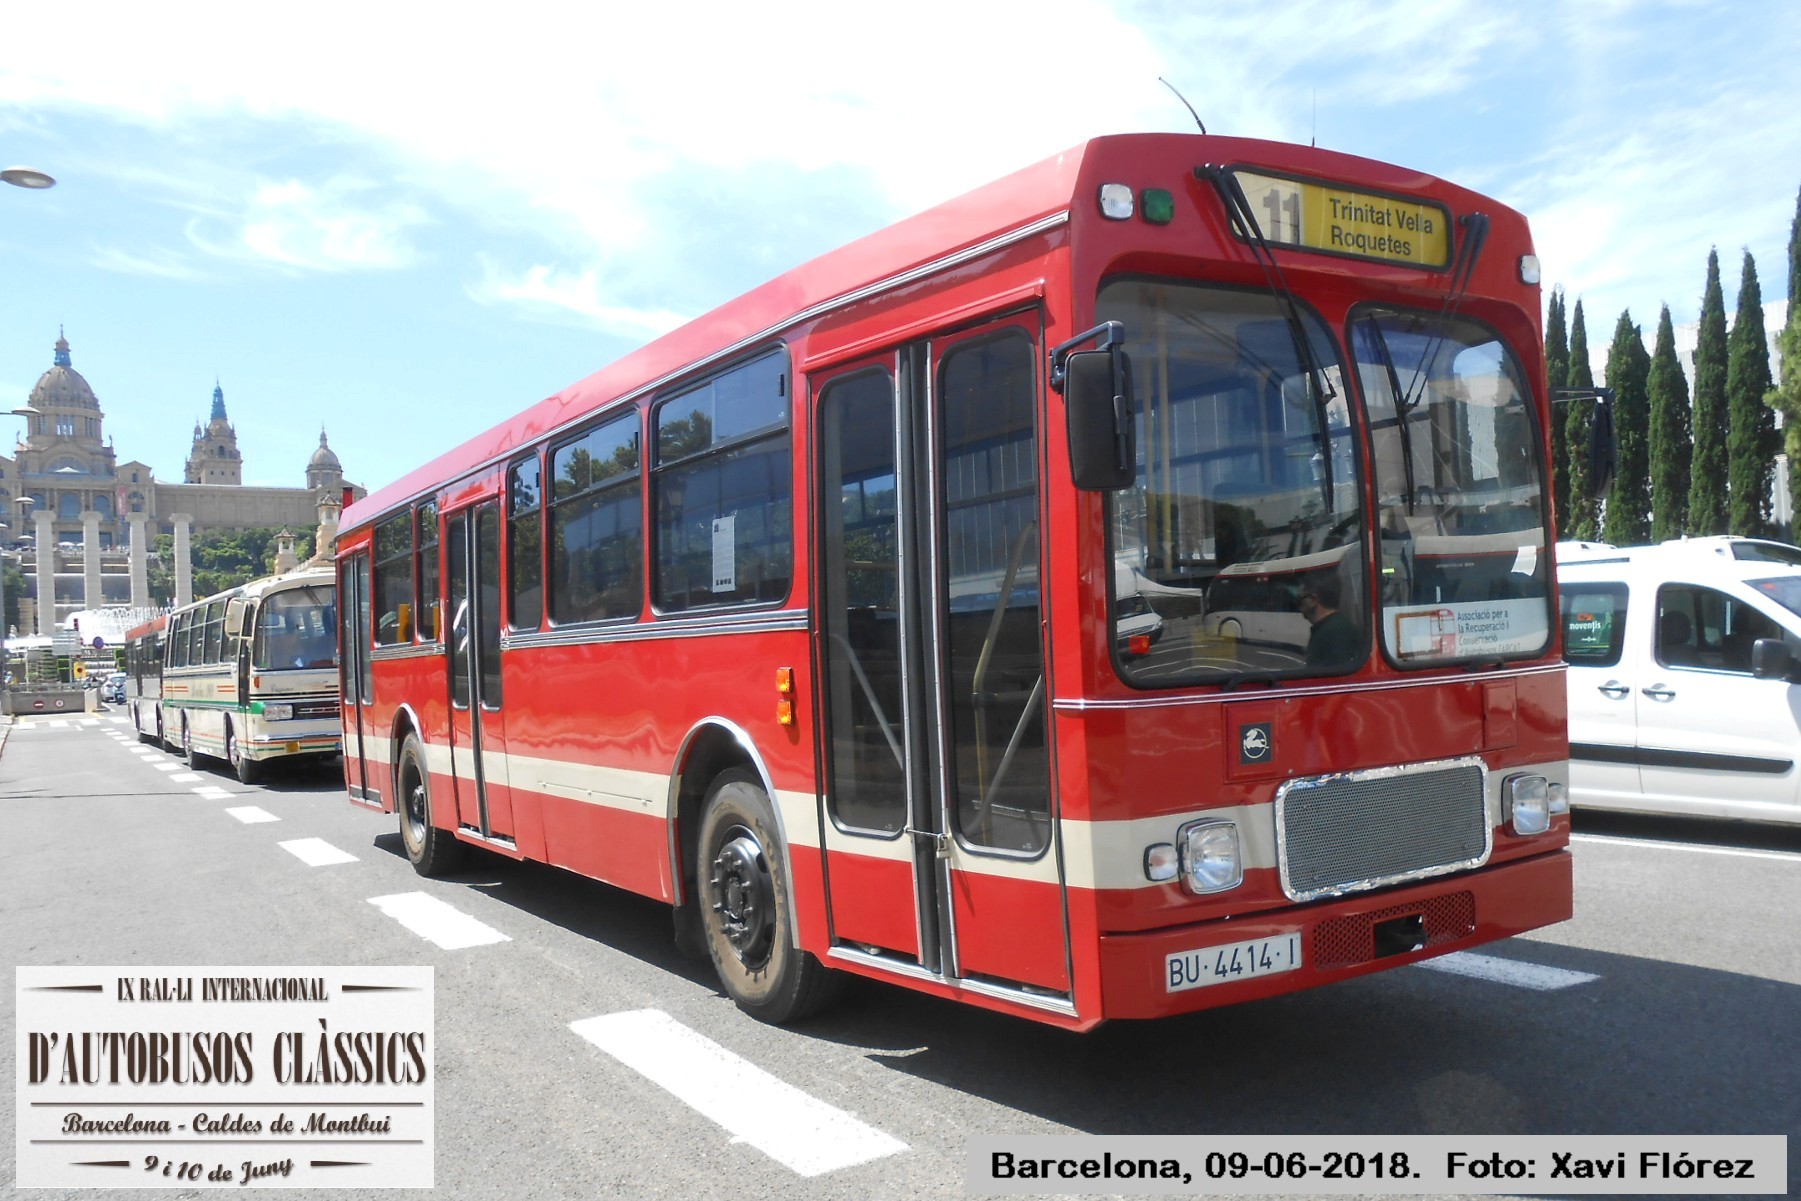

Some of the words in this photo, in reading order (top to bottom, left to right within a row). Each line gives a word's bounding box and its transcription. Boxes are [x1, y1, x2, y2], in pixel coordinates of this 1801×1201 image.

[1263, 189, 1300, 245] 11
[1329, 198, 1391, 227] Trinitat
[1395, 209, 1433, 234] Vella
[1331, 225, 1411, 256] Roquetes
[1458, 609, 1490, 621] Associació
[1492, 610, 1503, 621] per
[1465, 621, 1505, 634] Recuperació
